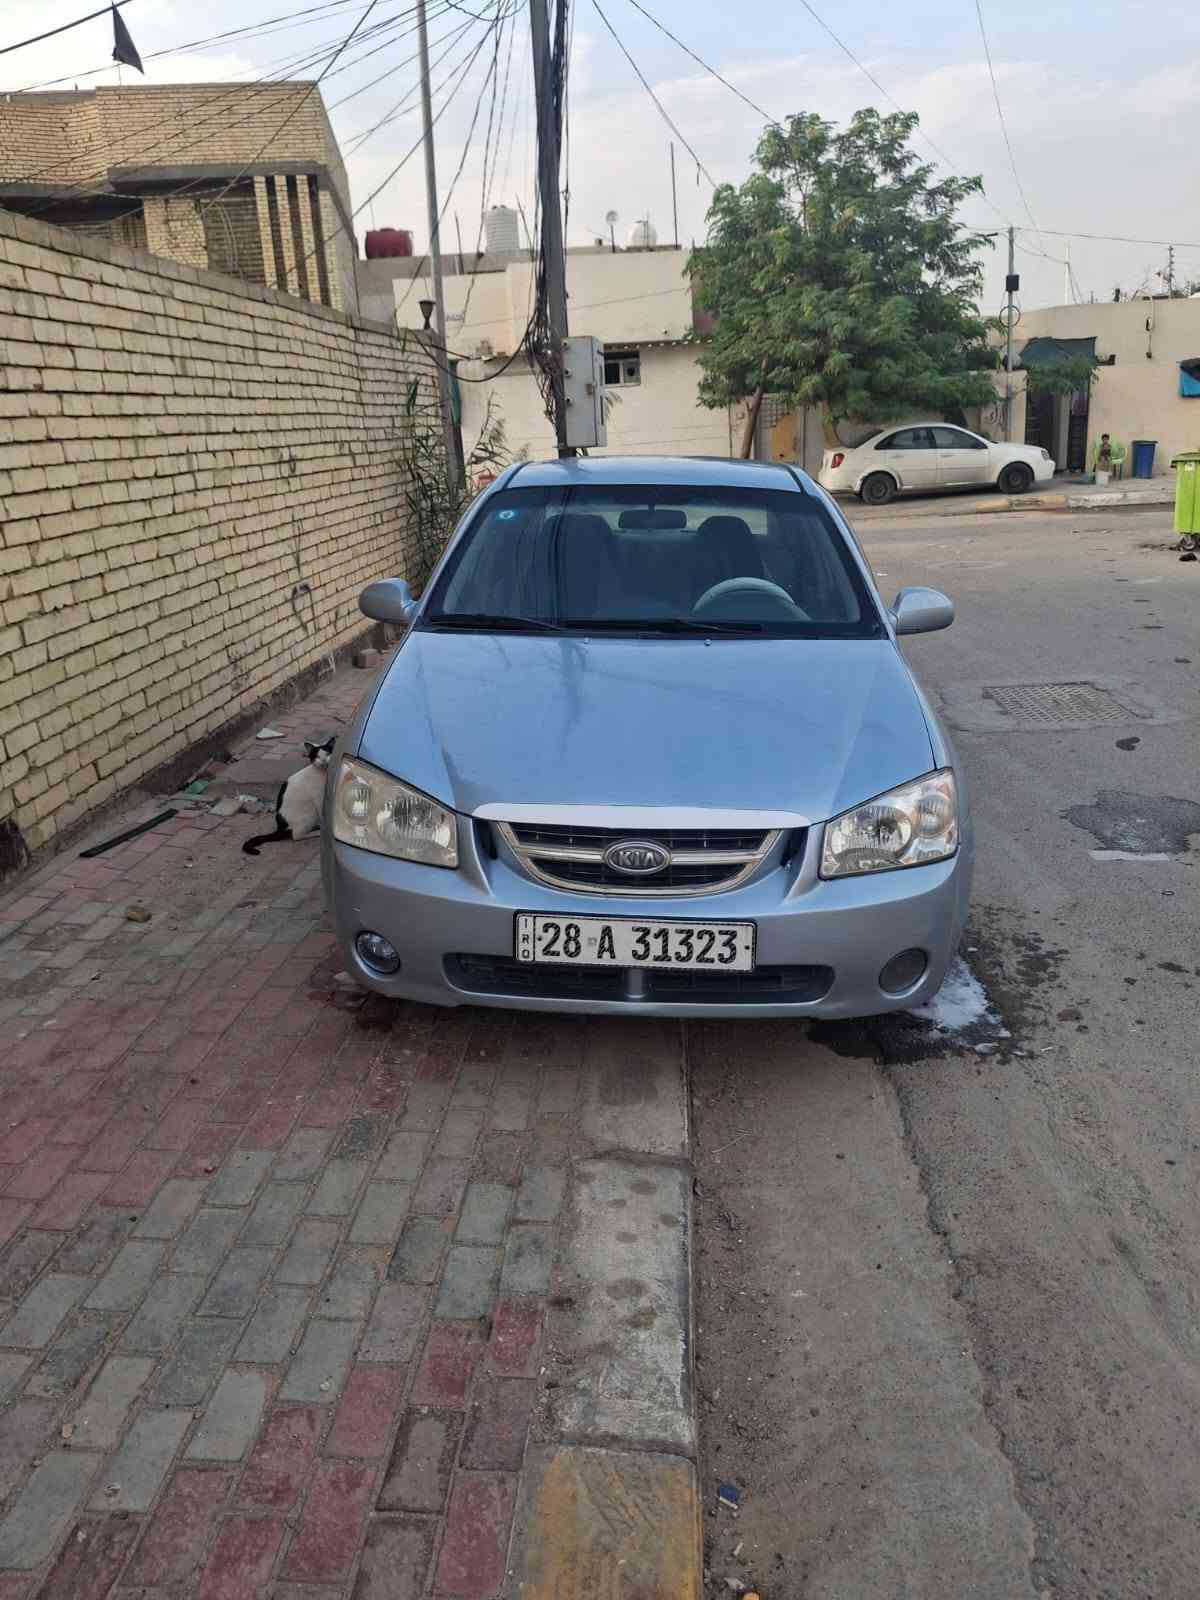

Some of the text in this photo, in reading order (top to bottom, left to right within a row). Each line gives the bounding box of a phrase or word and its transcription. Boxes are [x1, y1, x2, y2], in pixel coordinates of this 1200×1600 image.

[619, 850, 656, 866] KIA
[542, 922, 738, 964] 28 A 31323
